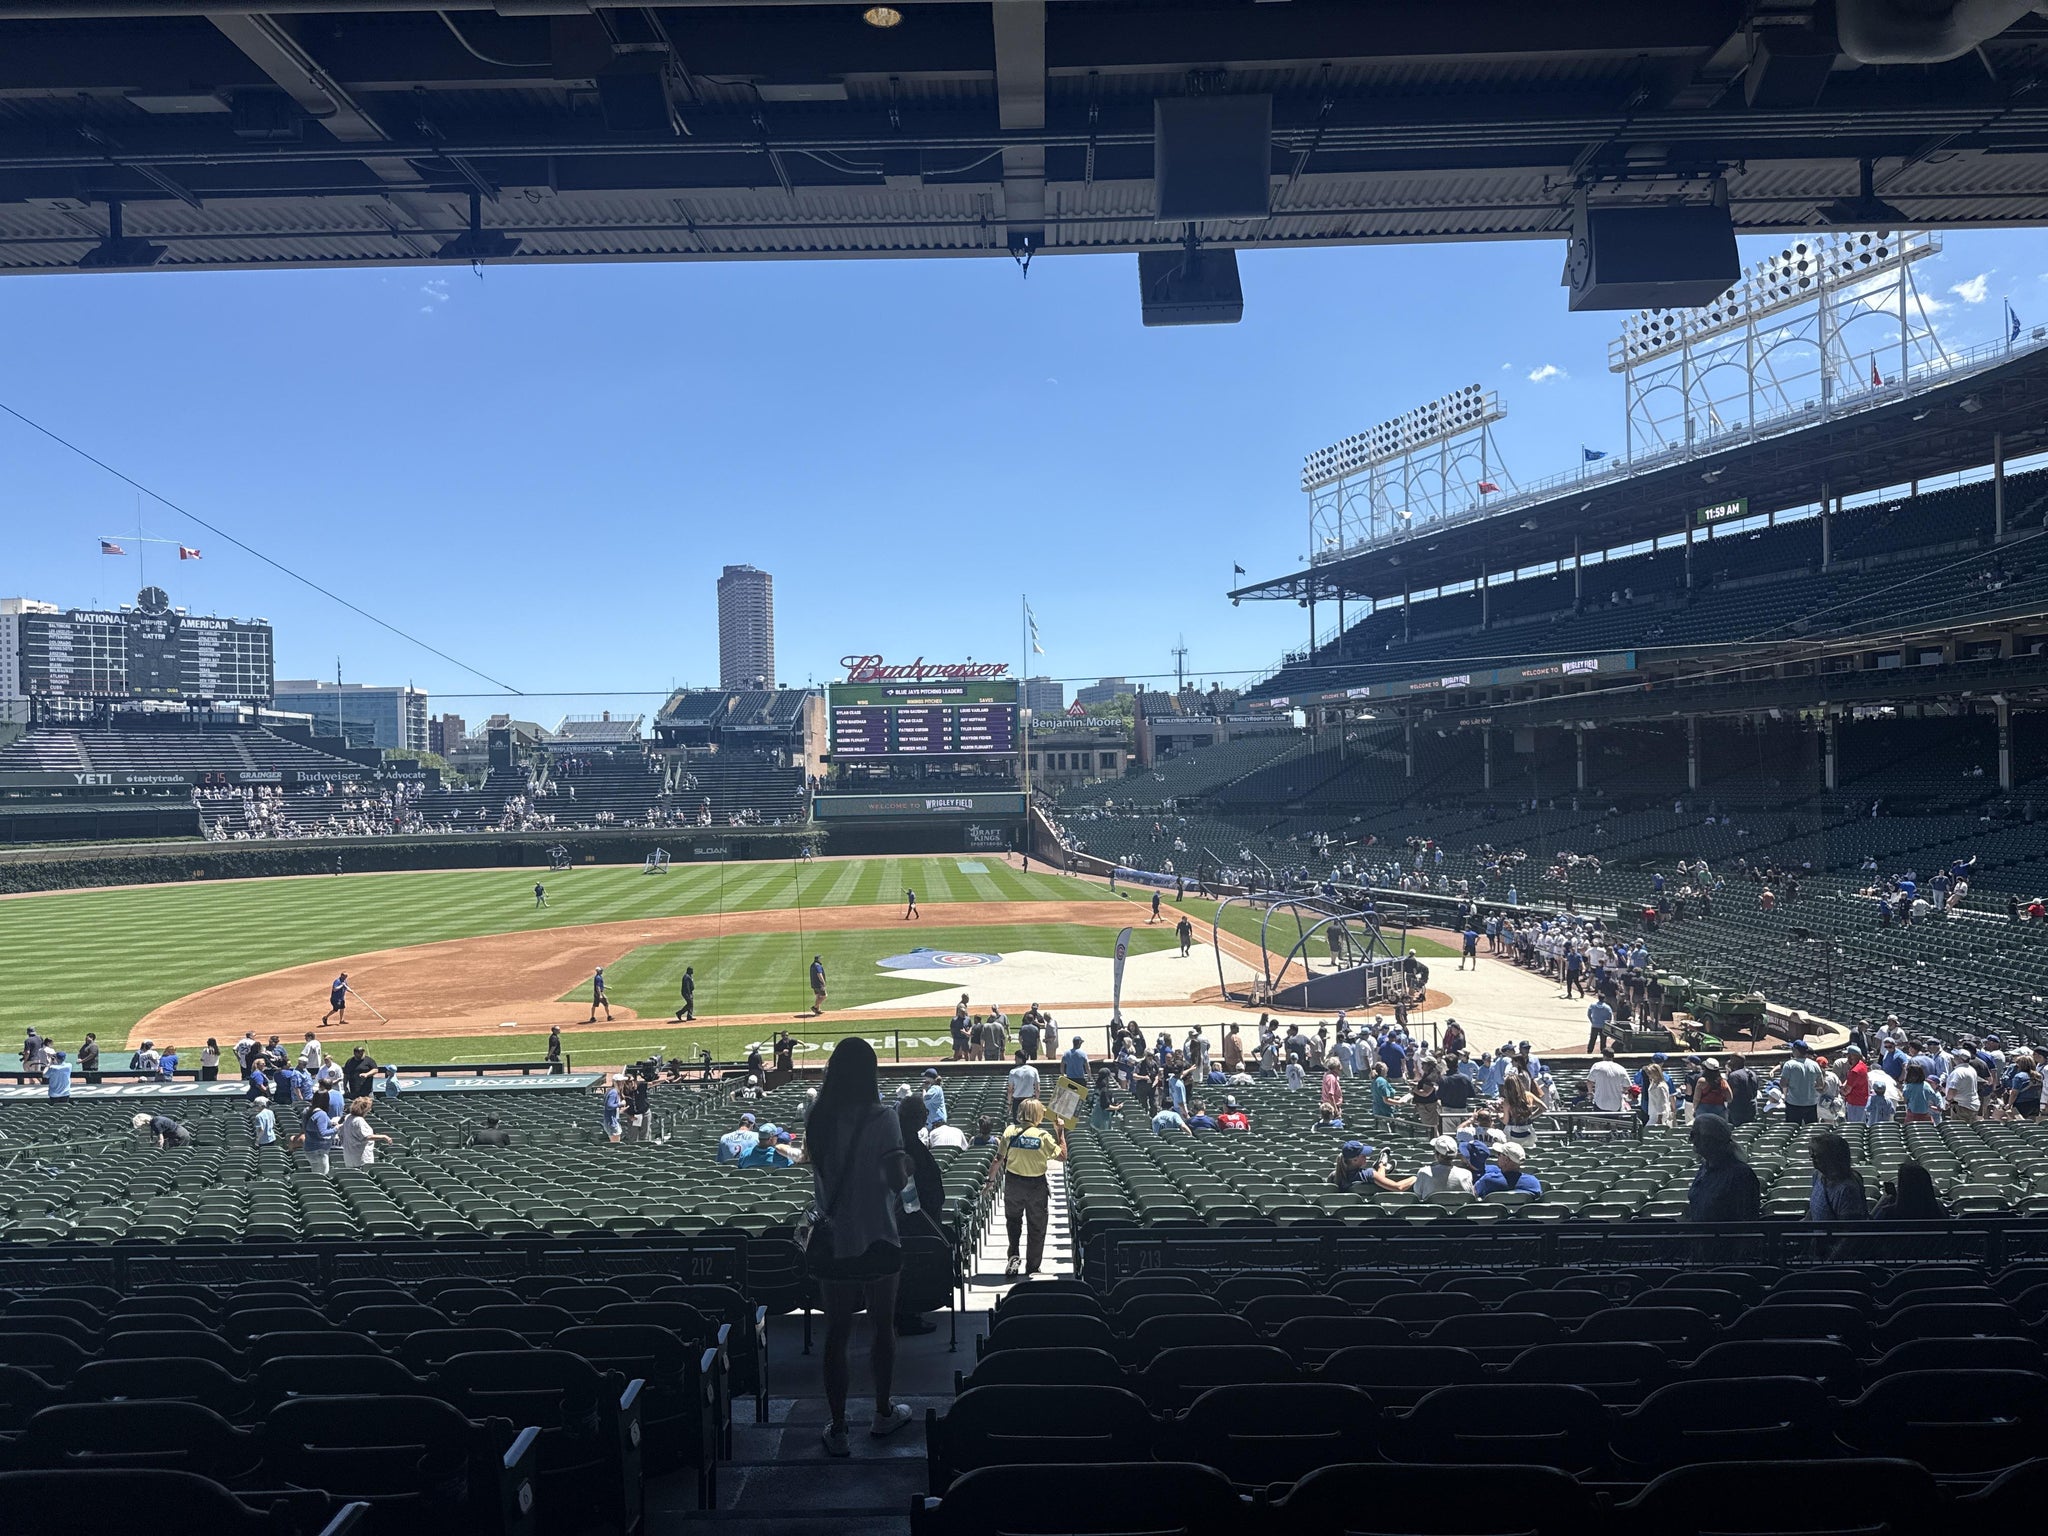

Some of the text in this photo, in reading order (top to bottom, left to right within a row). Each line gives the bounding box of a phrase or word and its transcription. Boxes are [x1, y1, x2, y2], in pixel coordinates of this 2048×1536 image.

[1704, 502, 1740, 520] 11:59 AM
[75, 613, 128, 624] NATIONAL
[180, 619, 228, 630] AMERICAN
[840, 654, 1009, 682] Budweiser
[1522, 668, 1549, 676] WELCOME
[1562, 661, 1584, 674] WRIGLEY
[1584, 659, 1598, 670] FIELD
[1032, 718, 1122, 728] Benjamin Moore
[74, 774, 112, 784] YETI
[133, 775, 184, 784] tastytrade
[926, 799, 954, 809] WRIGLEY
[955, 799, 972, 808] FIELD
[970, 828, 1000, 837] DRAFT
[446, 1078, 591, 1086] WINTRUST
[1140, 1250, 1161, 1268] 213
[692, 1257, 712, 1276] 212
